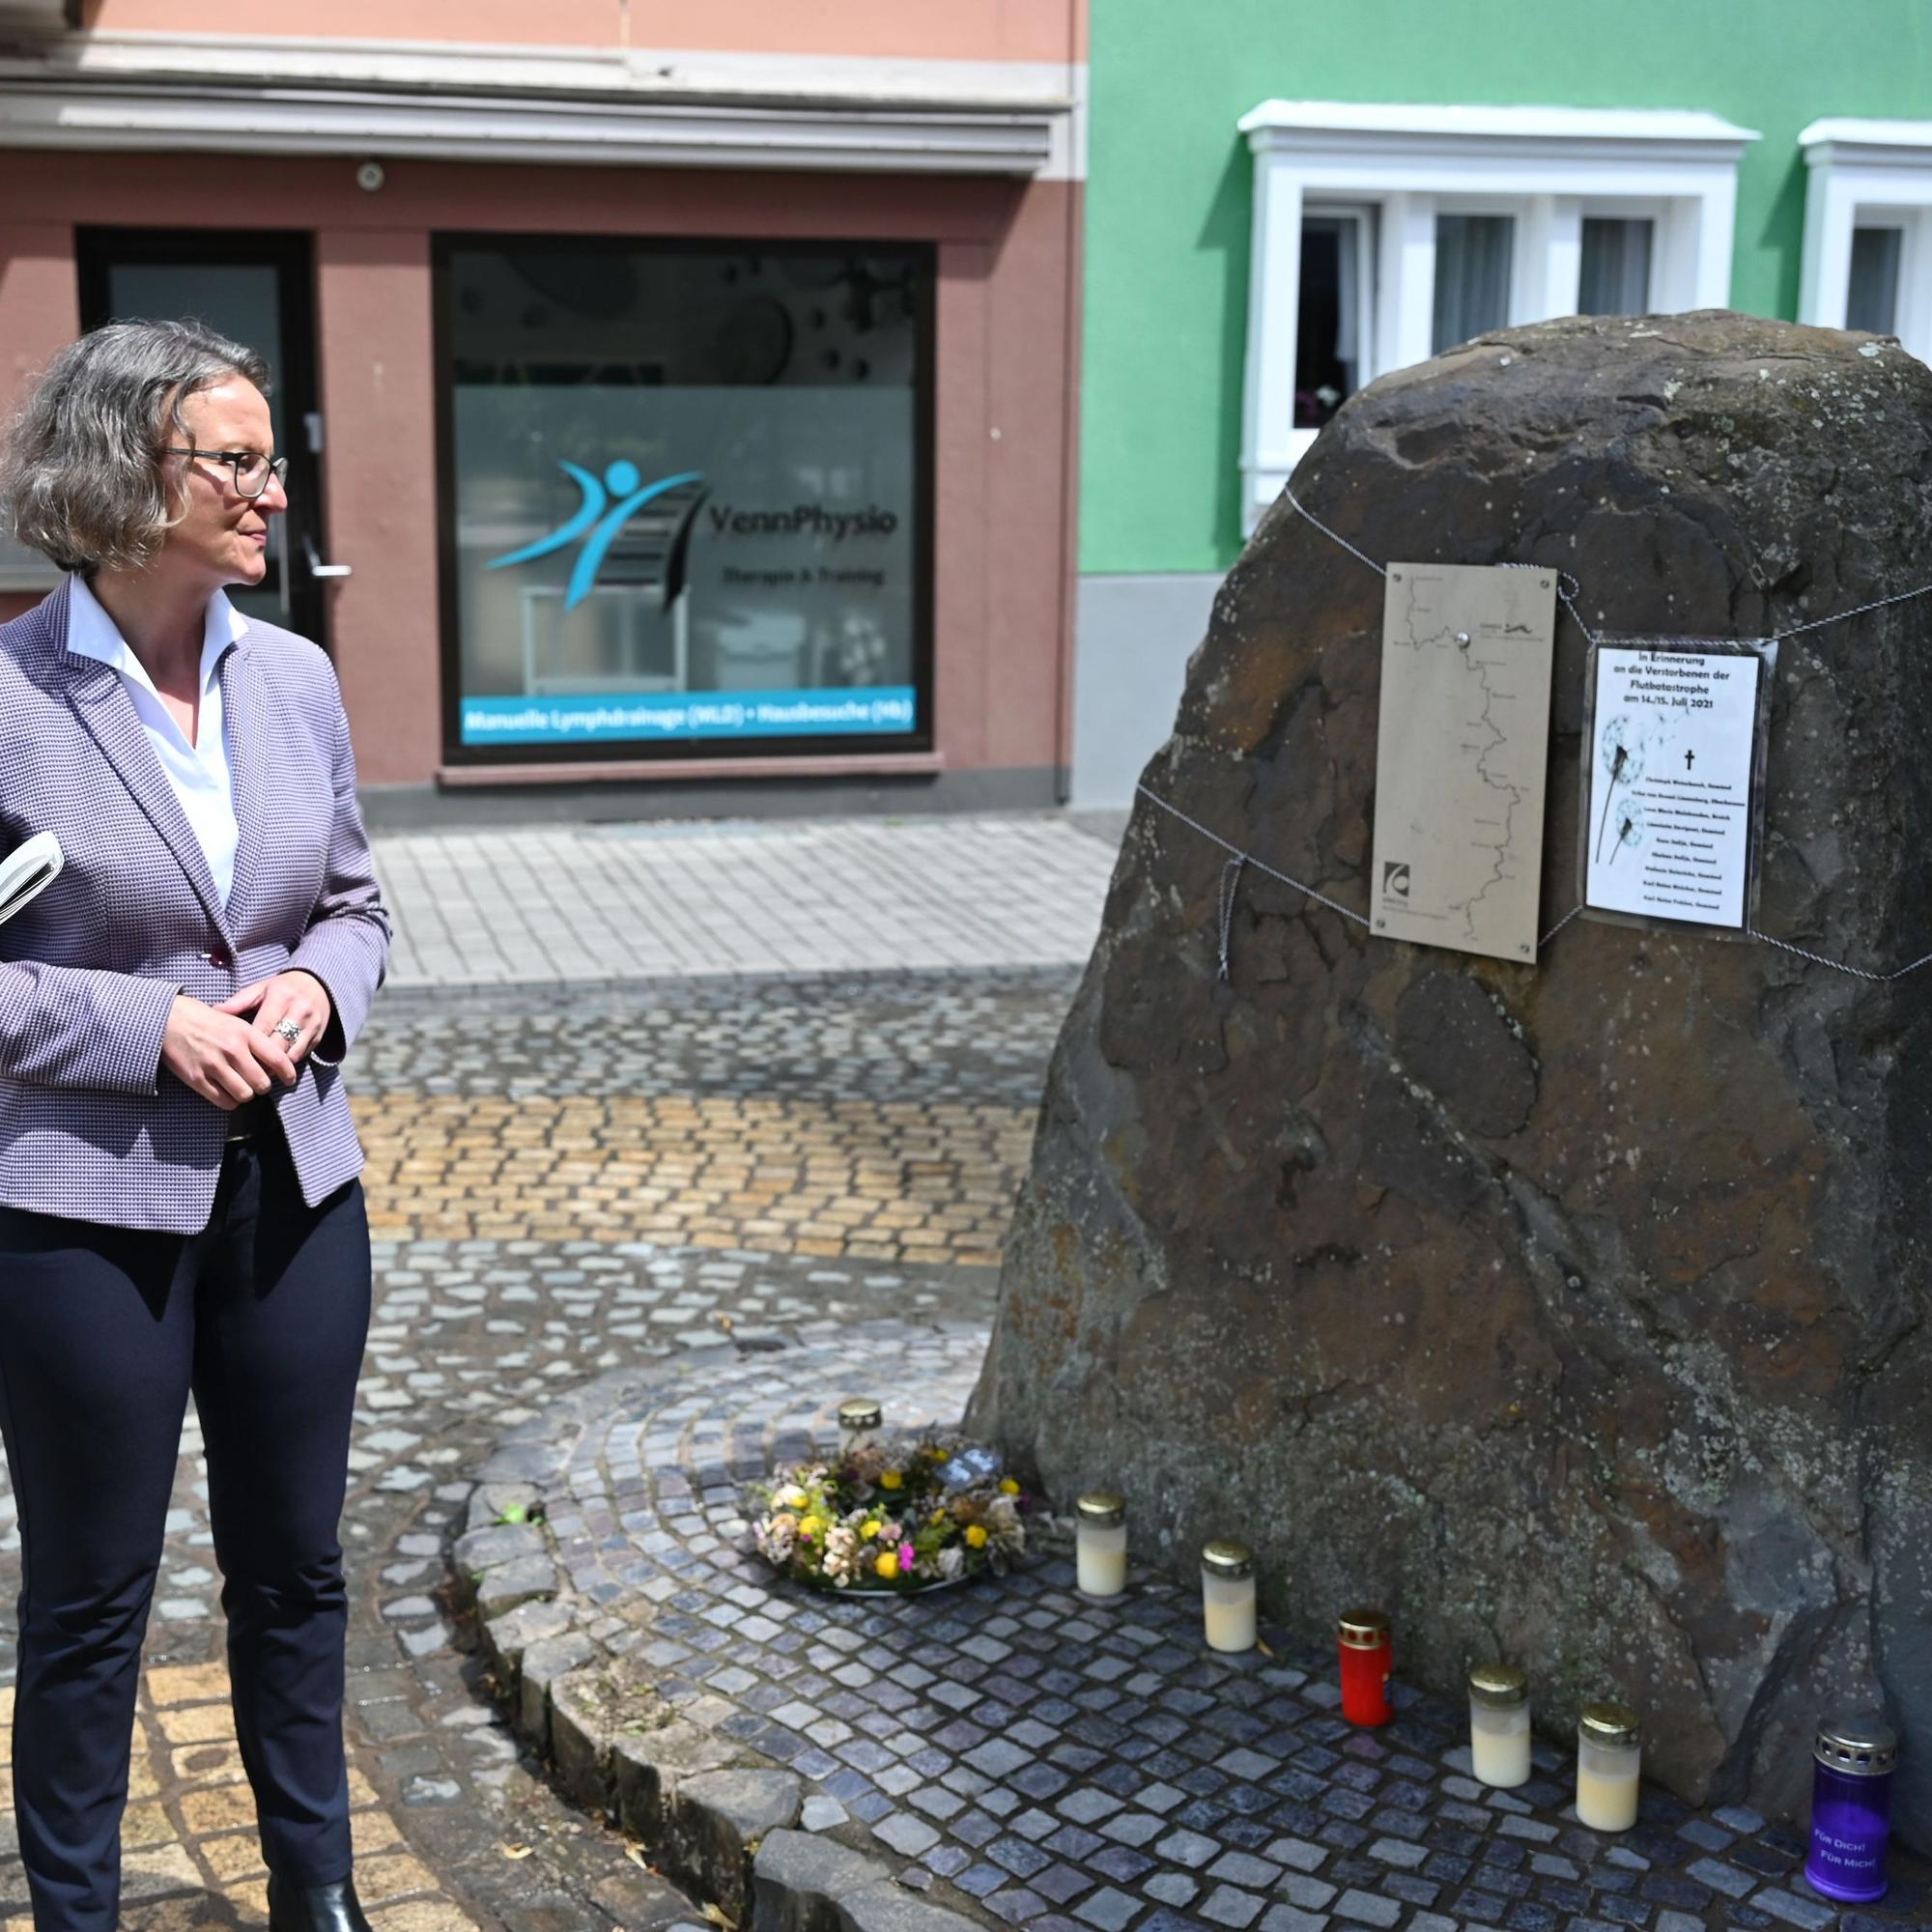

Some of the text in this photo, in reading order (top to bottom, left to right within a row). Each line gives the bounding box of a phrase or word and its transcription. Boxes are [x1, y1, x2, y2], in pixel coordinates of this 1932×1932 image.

[709, 504, 897, 541] VennPhysio
[1638, 651, 1705, 667] In Erinnerung
[1628, 666, 1643, 675] die
[1645, 667, 1710, 679] Verstorbenen
[1713, 670, 1730, 680] der
[1623, 695, 1639, 703] am
[1671, 697, 1689, 707] Juli
[1690, 698, 1714, 709] 2021
[465, 708, 548, 730] Manuelle
